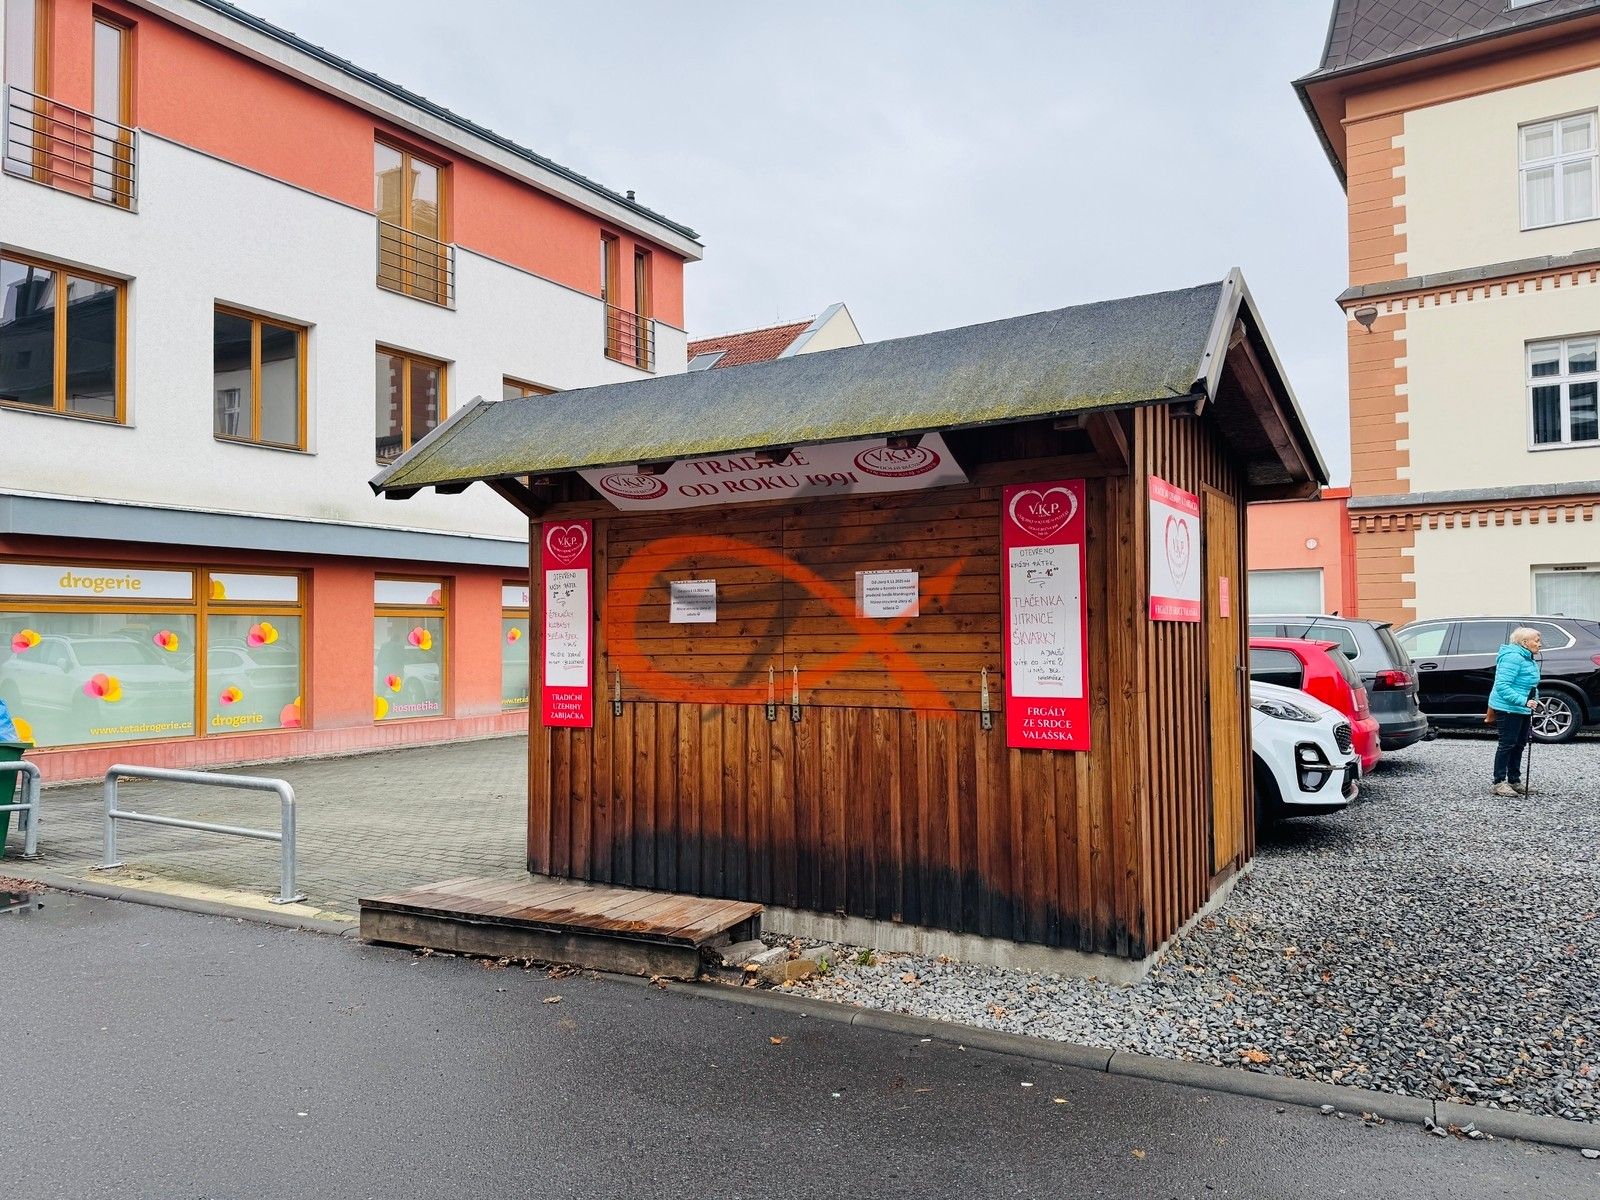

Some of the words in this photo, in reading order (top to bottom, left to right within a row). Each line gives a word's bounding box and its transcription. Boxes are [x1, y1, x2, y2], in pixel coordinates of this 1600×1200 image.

[678, 482, 719, 498] OD
[722, 474, 800, 494] ROKU
[805, 471, 859, 487] 1991
[1028, 501, 1061, 517] V.K.P.
[59, 571, 142, 593] drogerie
[1013, 594, 1065, 609] TLAČENKA
[1013, 611, 1055, 625] JITRNICE
[1012, 628, 1056, 646] ŠKVARKY
[552, 693, 583, 701] TRADIČNÍ
[392, 700, 439, 713] kosmetika
[1027, 705, 1066, 717] FRGÁLY
[211, 712, 264, 728] drogerie
[550, 711, 584, 720] ZABIJAČKA
[89, 721, 193, 735] www.tetadrogerie.cz
[1023, 718, 1035, 727] ZE
[1037, 719, 1073, 729] SRDCE
[1022, 730, 1073, 741] VALAŠSKA
